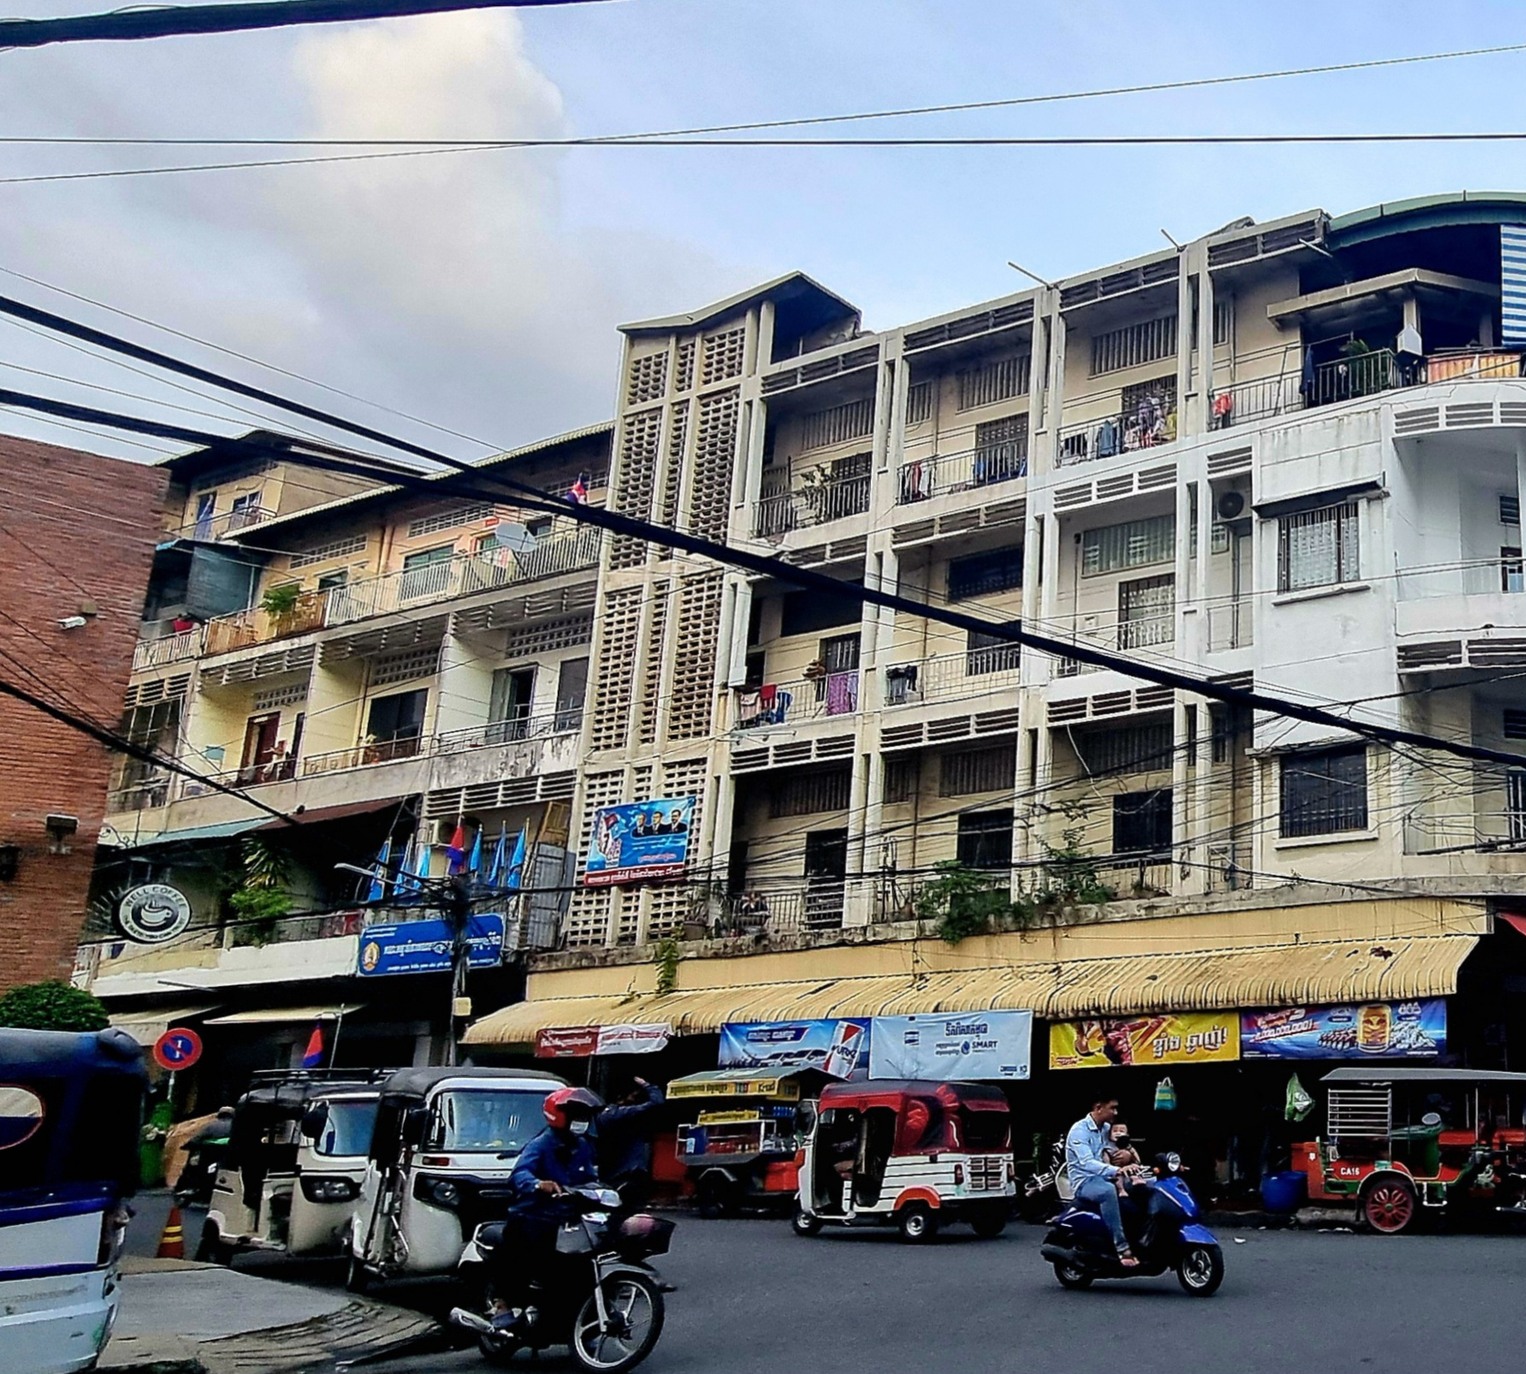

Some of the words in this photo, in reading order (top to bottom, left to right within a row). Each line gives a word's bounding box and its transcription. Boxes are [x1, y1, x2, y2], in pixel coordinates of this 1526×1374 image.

[125, 888, 149, 907] WELL
[152, 886, 187, 909] COFFEE
[972, 1041, 998, 1049] SMART
